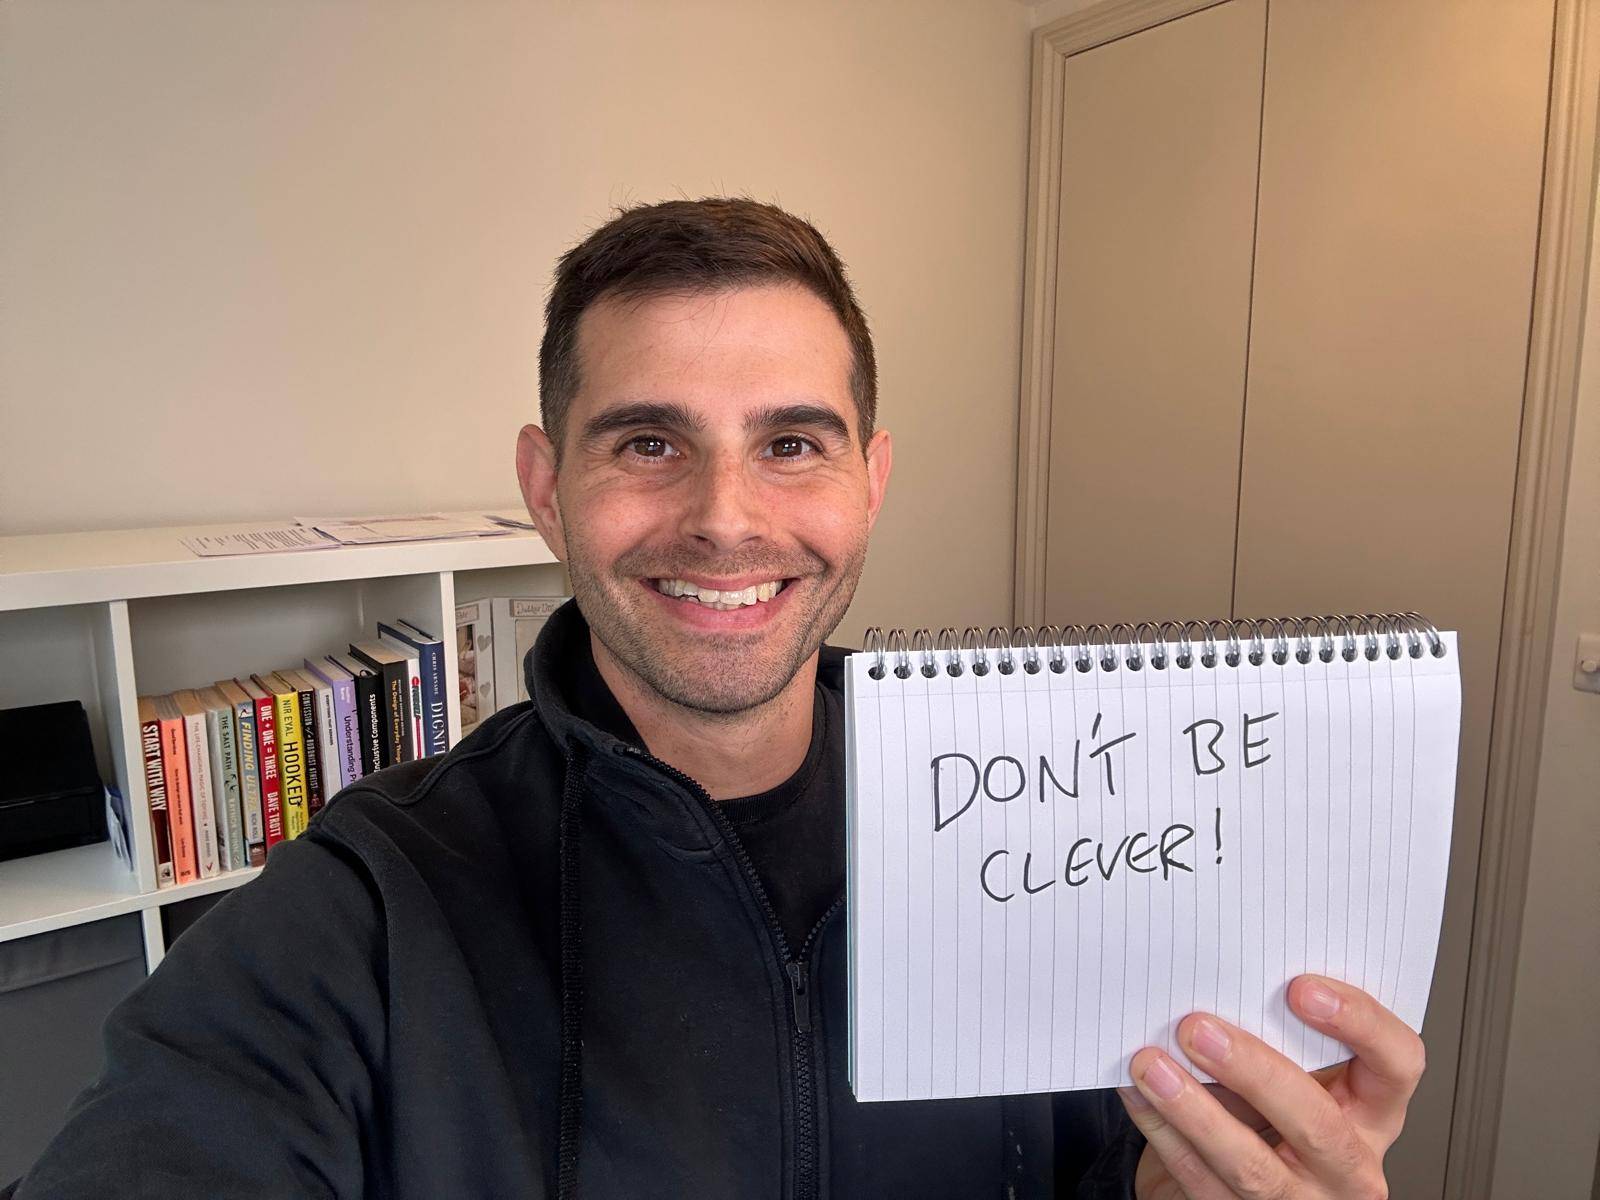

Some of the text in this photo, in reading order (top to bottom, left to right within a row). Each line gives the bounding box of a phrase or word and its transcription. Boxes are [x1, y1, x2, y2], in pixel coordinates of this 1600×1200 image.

[261, 705, 272, 721] ONE
[263, 730, 274, 745] ONE
[283, 700, 294, 736] NIR EYAL
[369, 693, 380, 772] Inclusive Components
[143, 724, 166, 811] START WITH WHY
[241, 721, 255, 770] FINDING
[265, 754, 277, 780] THREE
[344, 715, 356, 772] Understanding
[284, 742, 303, 808] HOOKED
[931, 711, 1279, 832] DON'T BE
[268, 792, 281, 837] DAVE TROTT
[980, 807, 1222, 902] CLEVER!
